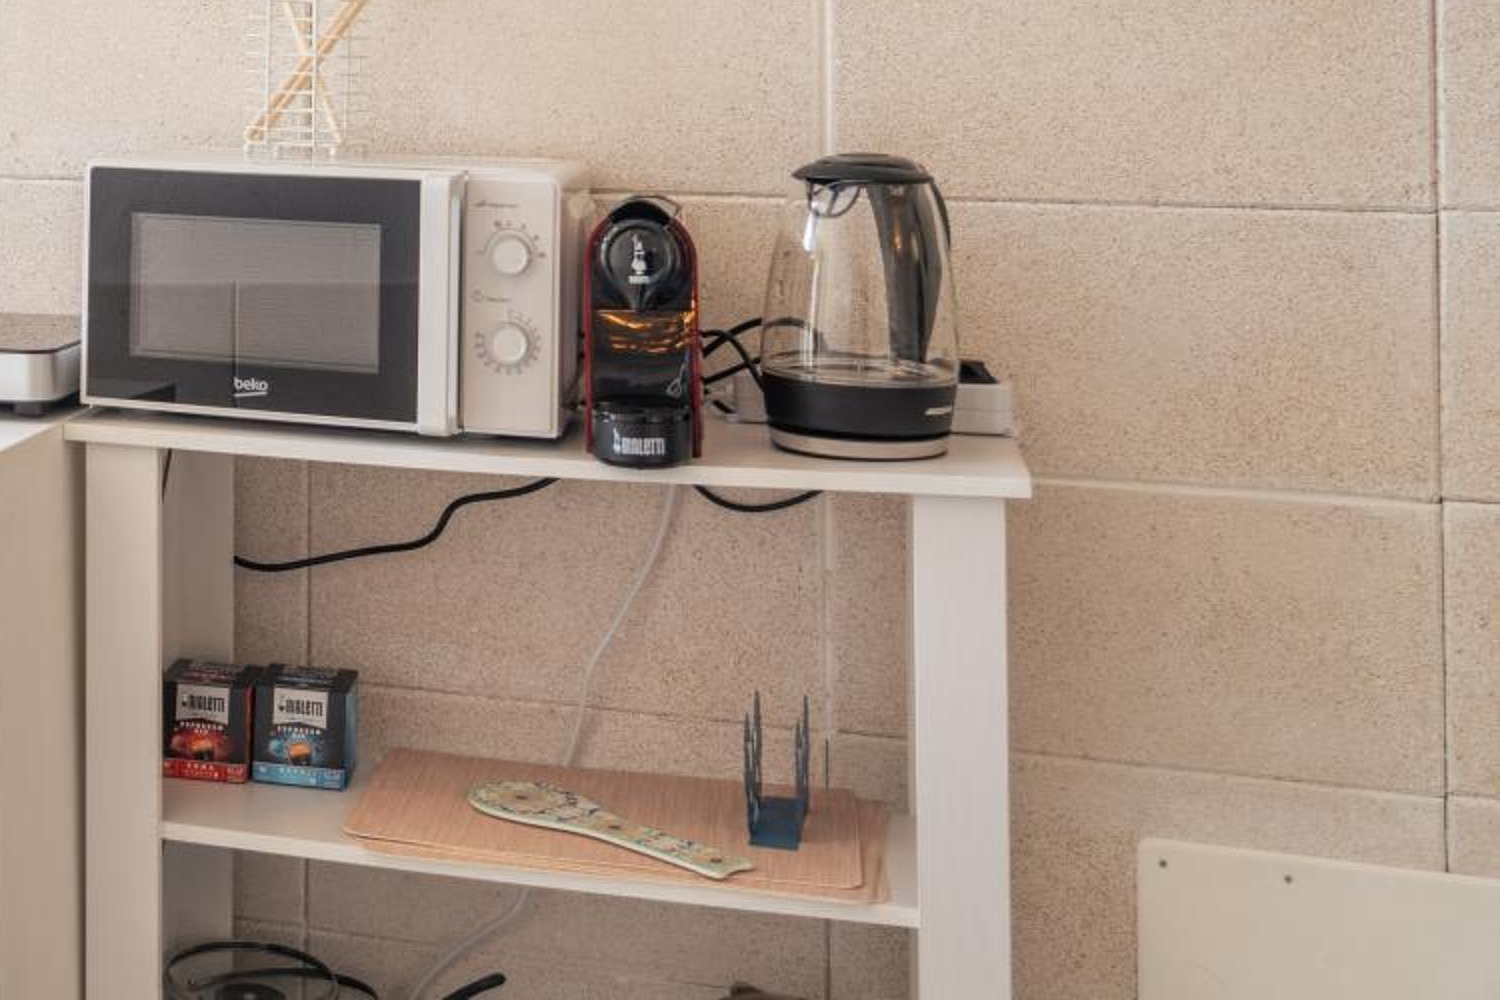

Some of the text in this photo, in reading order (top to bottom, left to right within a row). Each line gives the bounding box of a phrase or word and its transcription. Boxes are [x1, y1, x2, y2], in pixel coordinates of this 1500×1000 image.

[234, 377, 269, 391] beko
[621, 437, 665, 456] BIALETTI
[285, 699, 324, 717] BIALETTI
